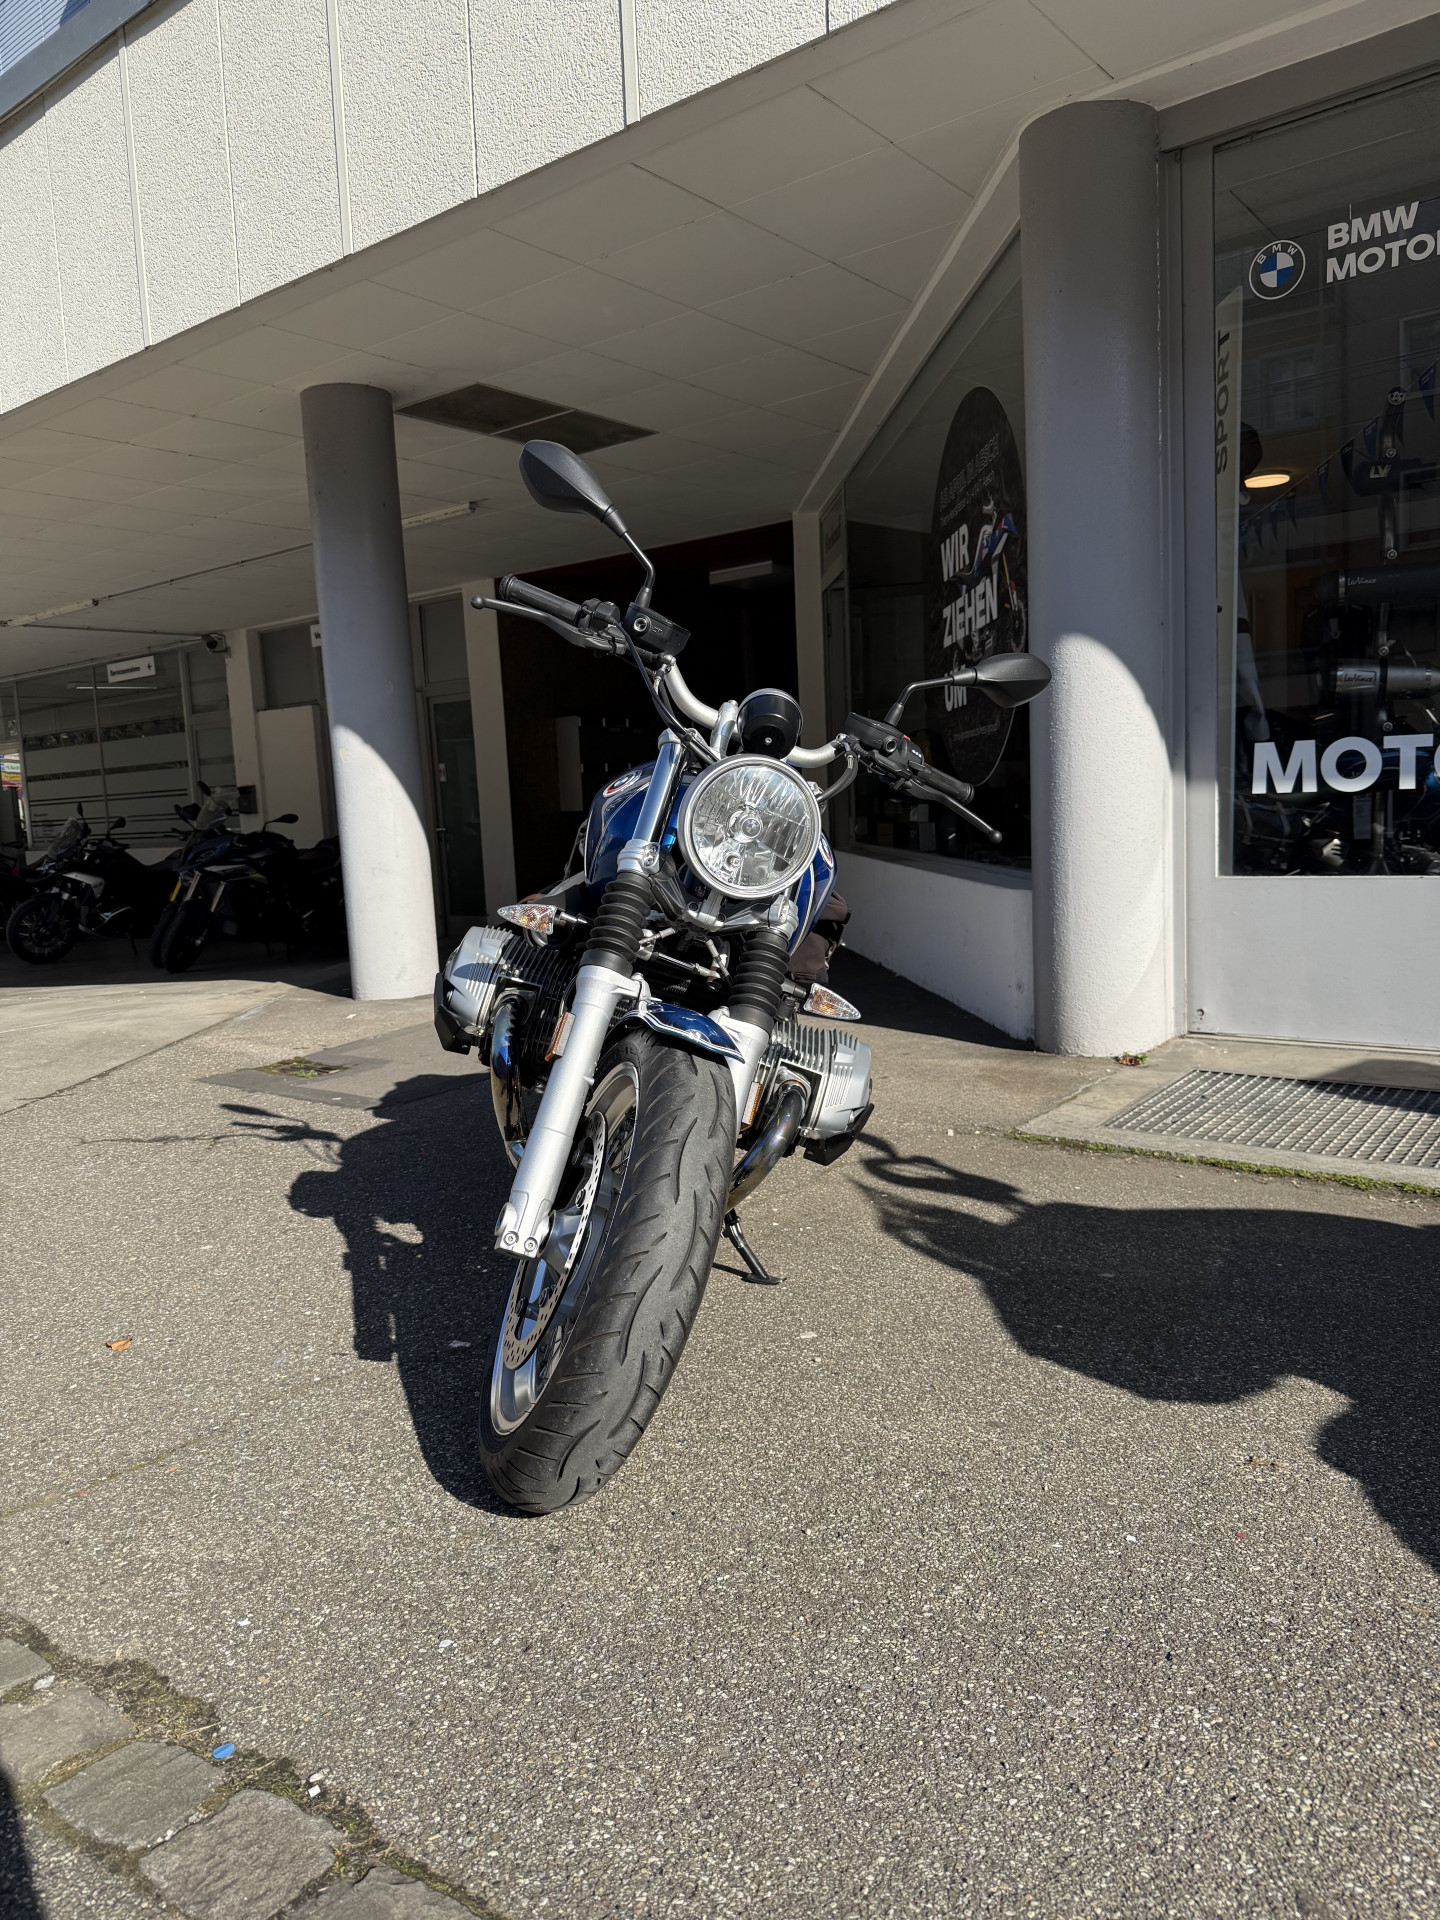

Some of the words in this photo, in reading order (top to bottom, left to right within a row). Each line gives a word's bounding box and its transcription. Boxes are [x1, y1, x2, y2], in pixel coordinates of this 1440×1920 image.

[1327, 201, 1419, 250] BMW
[1326, 229, 1440, 283] MOTO
[1215, 330, 1230, 475] SPORT
[975, 433, 999, 478] AESCH
[1369, 464, 1391, 479] LV
[940, 523, 970, 583] WIR
[942, 569, 999, 649] ZIEHEN
[944, 664, 968, 713] UM
[1251, 733, 1440, 795] MOT
